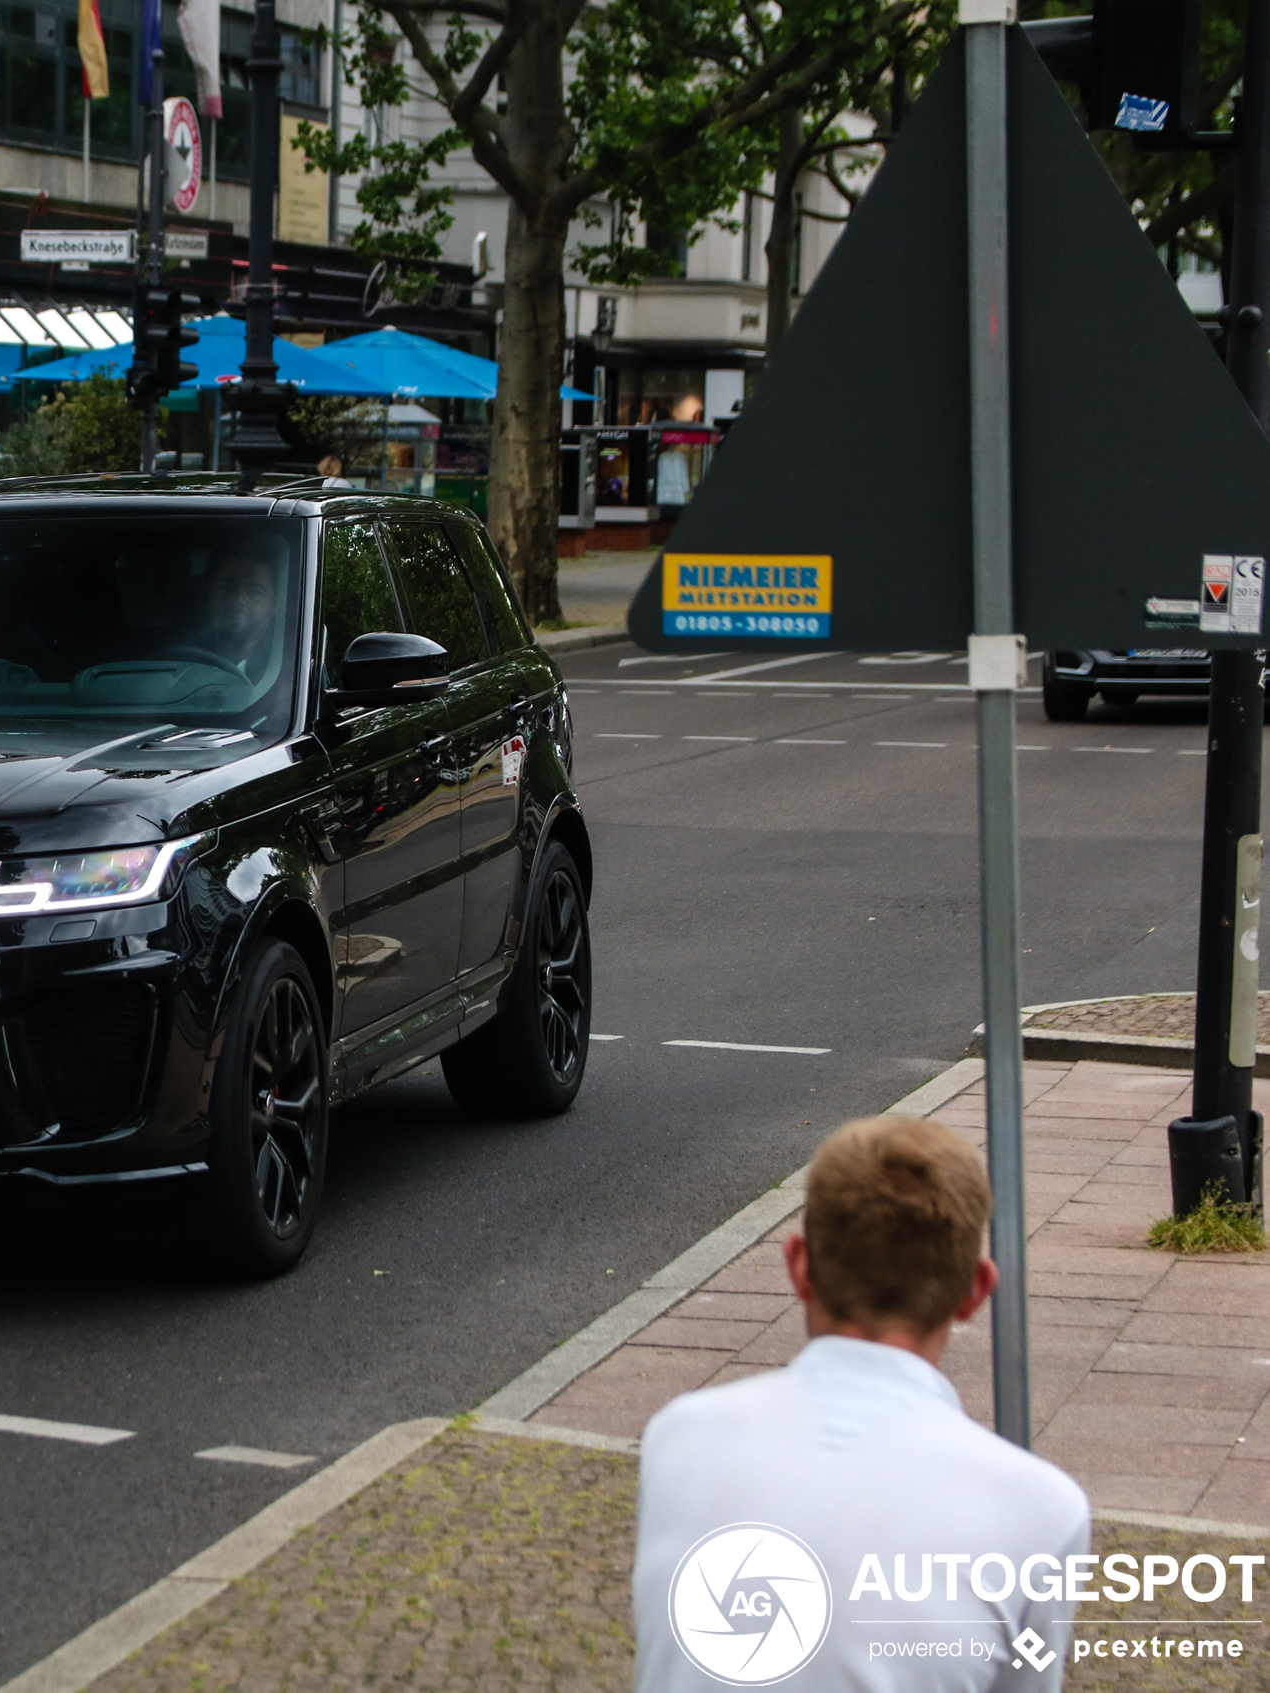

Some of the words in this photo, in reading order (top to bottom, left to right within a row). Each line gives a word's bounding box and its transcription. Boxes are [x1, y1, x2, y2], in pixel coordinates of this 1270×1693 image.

[29, 239, 124, 256] Knesebeckstraße
[679, 565, 820, 589] NIEMEIER
[679, 592, 818, 606] MIETSTATION
